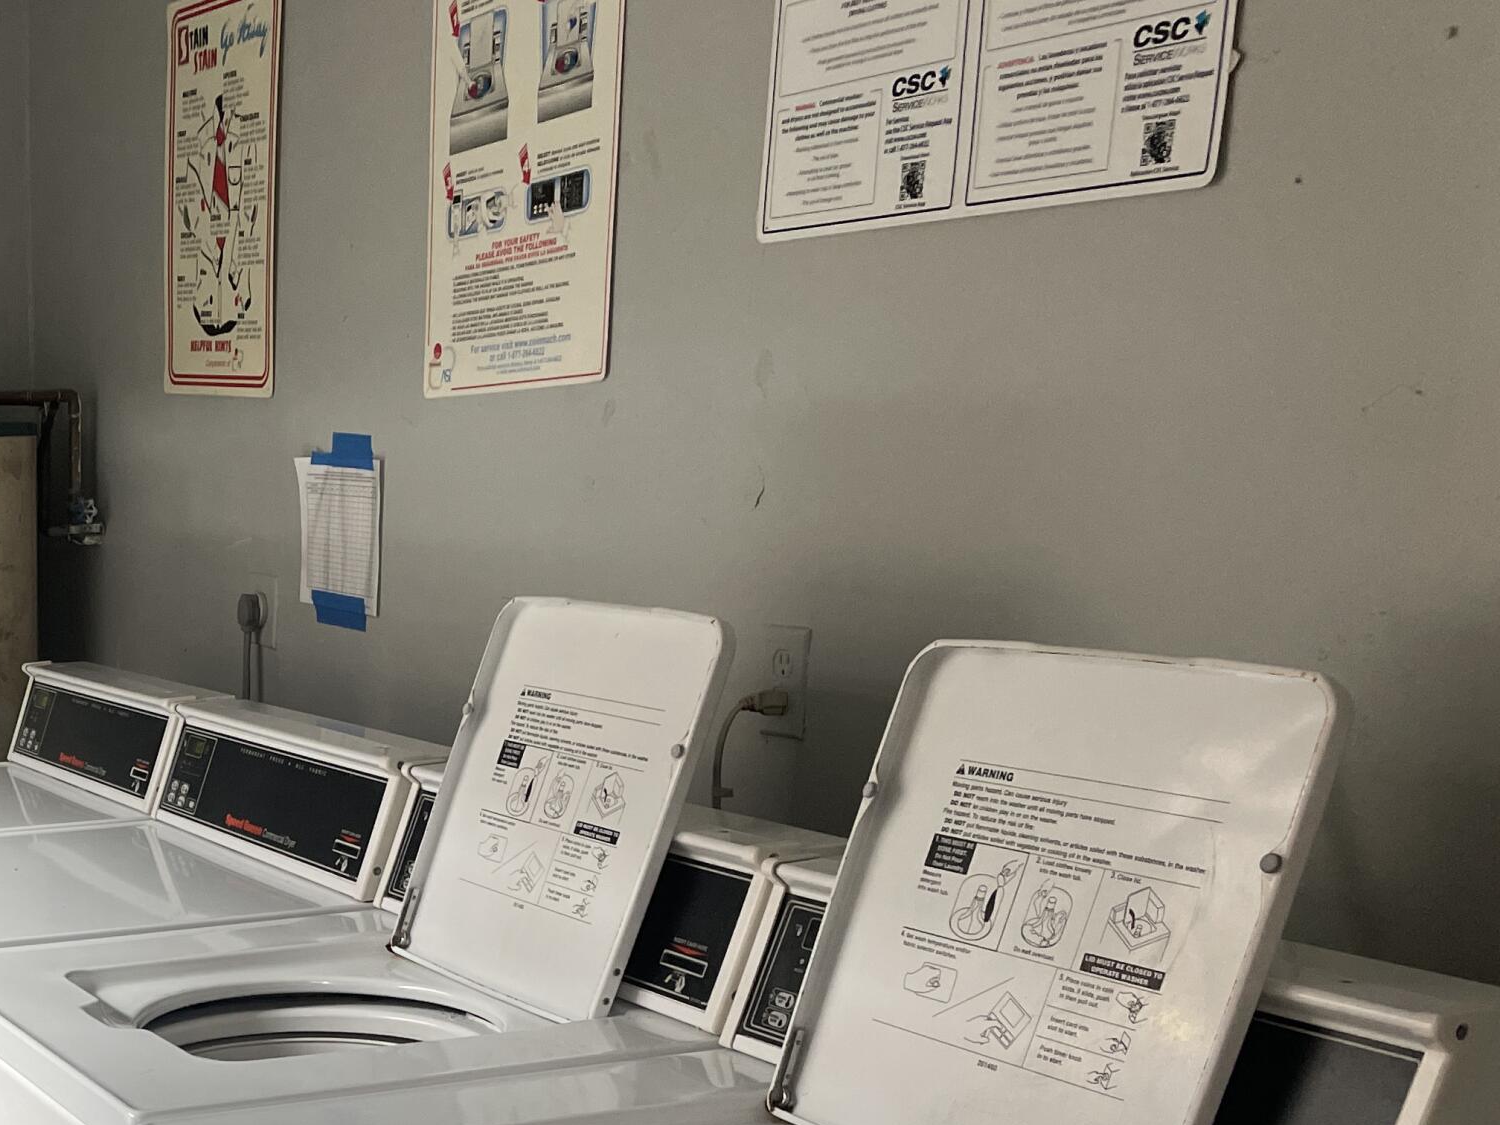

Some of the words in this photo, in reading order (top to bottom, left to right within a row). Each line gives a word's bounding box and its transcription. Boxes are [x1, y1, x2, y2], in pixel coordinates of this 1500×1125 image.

[1133, 17, 1191, 48] CSC
[178, 25, 209, 66] STAIN
[194, 48, 218, 75] STAIN
[892, 71, 936, 97] CSC
[475, 251, 494, 261] PLEASE
[496, 248, 512, 257] AVOID
[514, 245, 524, 253] THE
[526, 237, 557, 250] FOLLOWING
[492, 240, 502, 249] FOR
[504, 238, 518, 246] YOUR
[520, 233, 540, 243] SAFETY
[191, 340, 212, 352] HELPFUL
[471, 345, 480, 353] For
[497, 352, 506, 360] call
[526, 688, 552, 700] WARNING
[967, 765, 1015, 781] WARNING
[1117, 872, 1133, 882] Close
[1085, 954, 1096, 962] LID
[1097, 957, 1115, 967] MUST
[1116, 962, 1125, 970] BE
[1126, 965, 1152, 977] CLOSED
[1066, 975, 1080, 985] Place
[1102, 985, 1114, 994] coin
[1090, 965, 1120, 978] OPERATE
[1121, 973, 1149, 986] WASHER
[1051, 1015, 1065, 1025] Insert
[1067, 1020, 1078, 1028] card
[1040, 1044, 1053, 1053] Push
[1054, 1048, 1067, 1058] timer
[1068, 1053, 1082, 1062] knob
